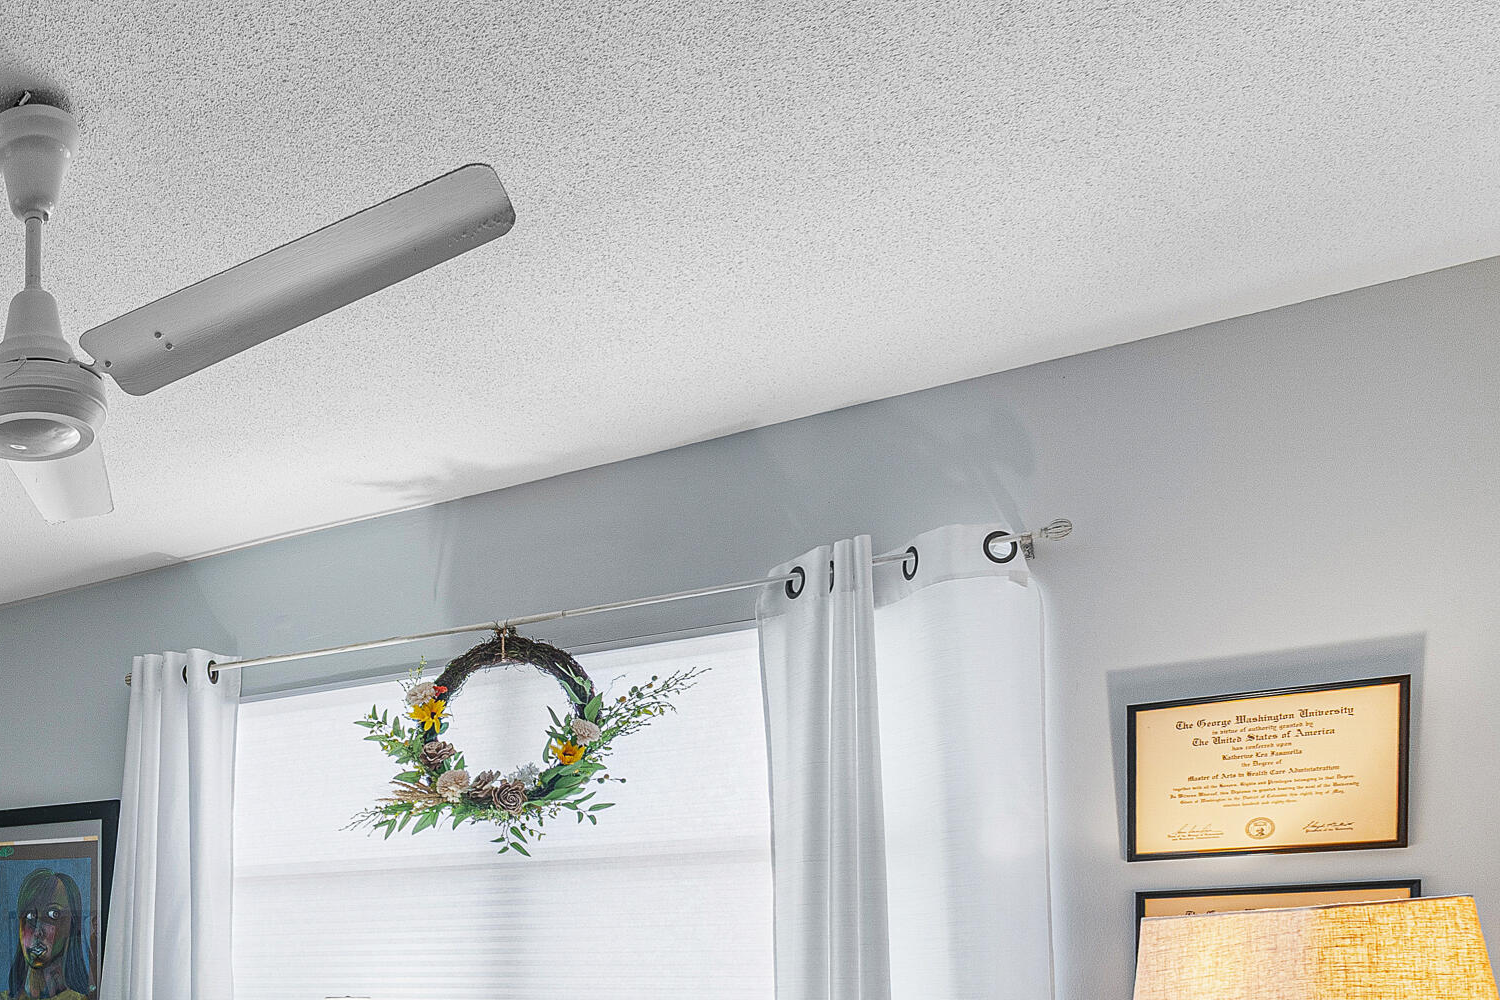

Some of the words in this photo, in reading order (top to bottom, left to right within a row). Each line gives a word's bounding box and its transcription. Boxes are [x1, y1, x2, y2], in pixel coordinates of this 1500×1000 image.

[1175, 720, 1194, 731] The
[1196, 718, 1232, 729] George
[1234, 713, 1295, 725] Washington
[1297, 706, 1355, 718] University
[1191, 737, 1209, 747] The
[1212, 736, 1242, 746] United
[1245, 733, 1278, 743] States
[1281, 730, 1292, 739] of
[1293, 727, 1336, 738] America
[1252, 760, 1274, 768] Degree
[1220, 772, 1237, 780] Arts
